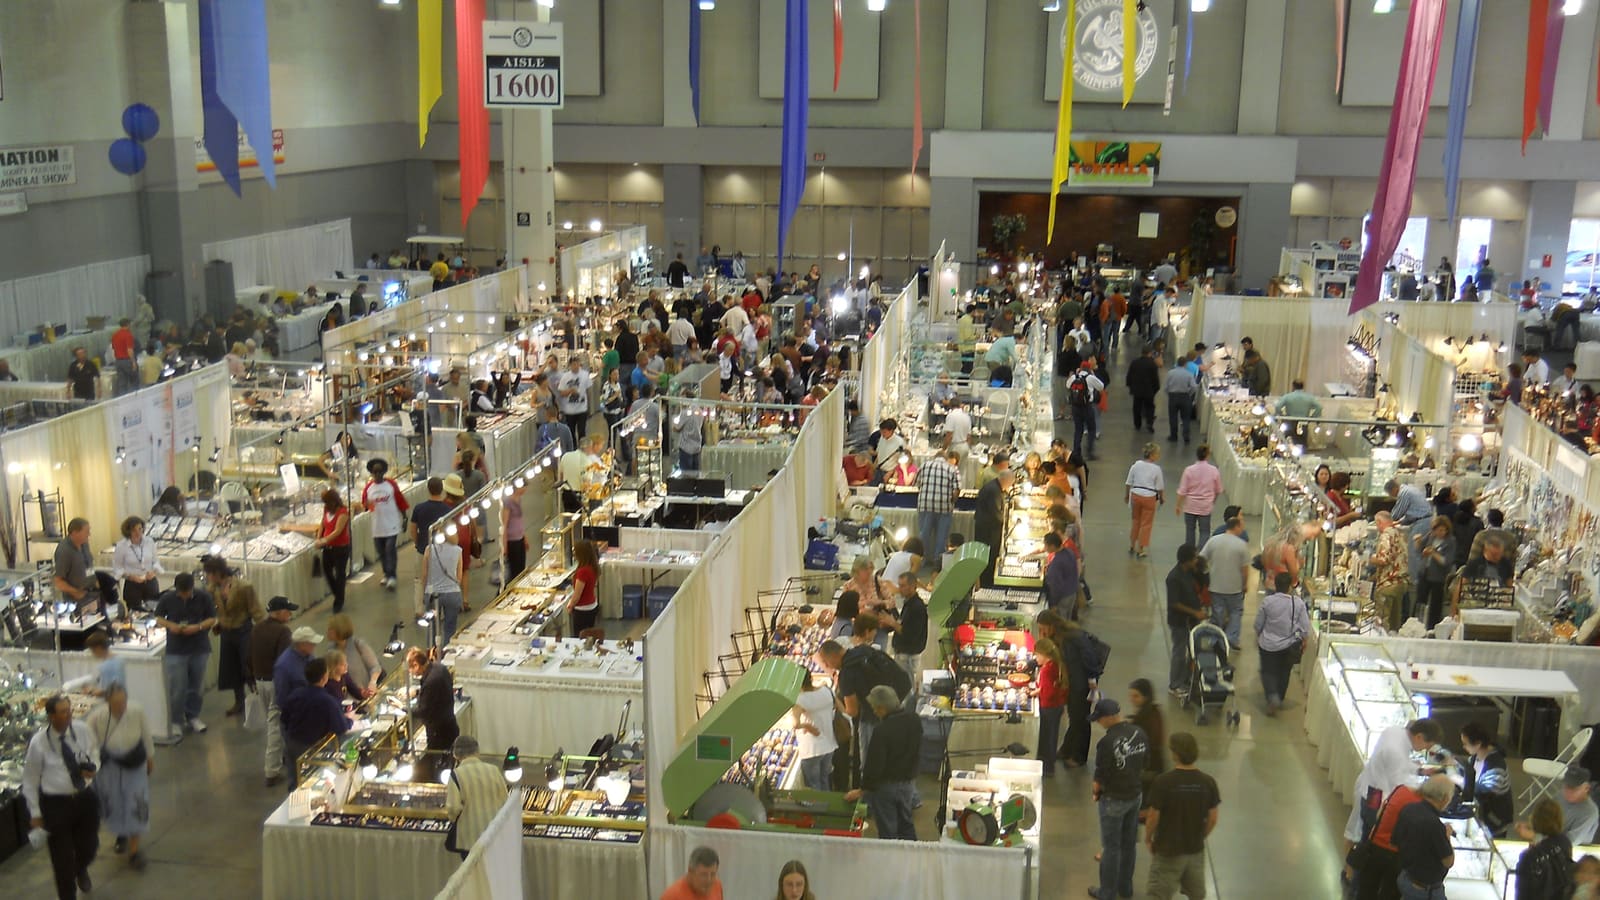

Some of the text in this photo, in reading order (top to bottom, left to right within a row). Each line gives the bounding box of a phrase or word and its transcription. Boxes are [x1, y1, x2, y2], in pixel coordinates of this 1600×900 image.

[504, 57, 544, 68] AISLE
[495, 73, 554, 98] 1600
[1072, 163, 1148, 175] TORTILLA
[1, 172, 69, 188] MINERAL SHOW
